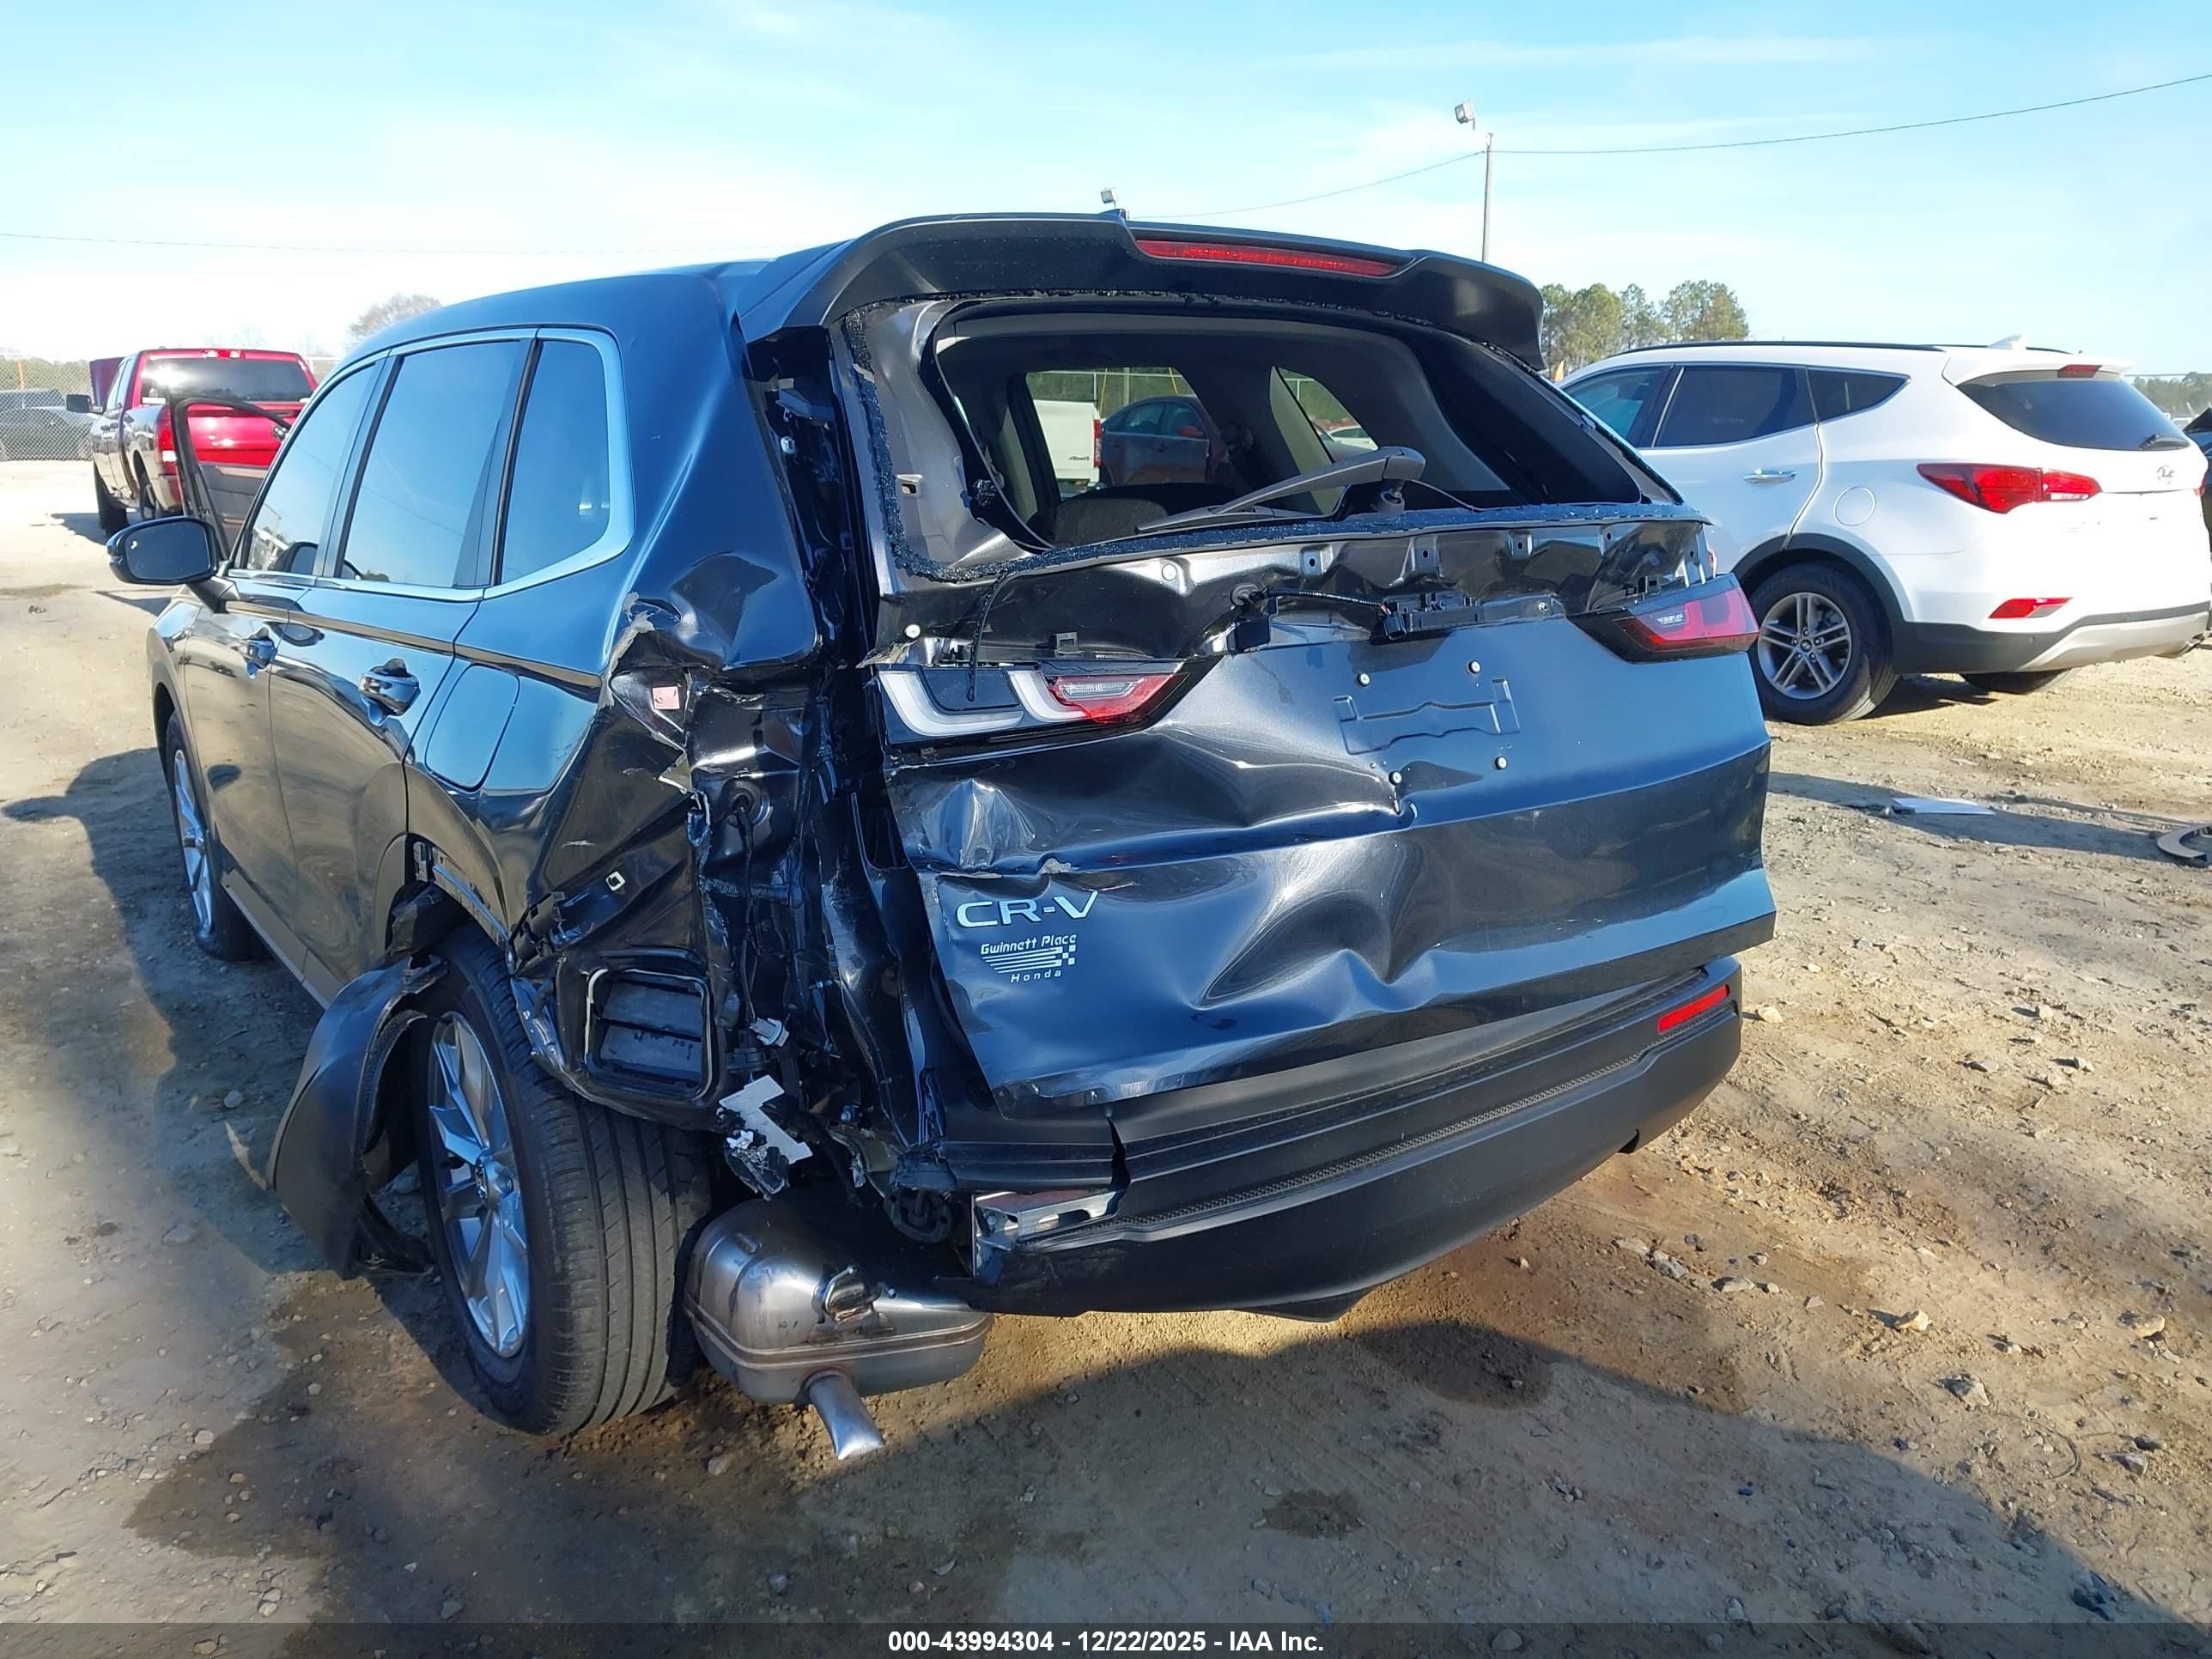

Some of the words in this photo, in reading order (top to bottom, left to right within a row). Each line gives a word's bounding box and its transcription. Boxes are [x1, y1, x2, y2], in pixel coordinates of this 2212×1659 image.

[957, 890, 1099, 927] CR-V
[980, 937, 1037, 955] Gwinnett
[1041, 933, 1077, 948] Place
[1010, 969, 1062, 983] Honda
